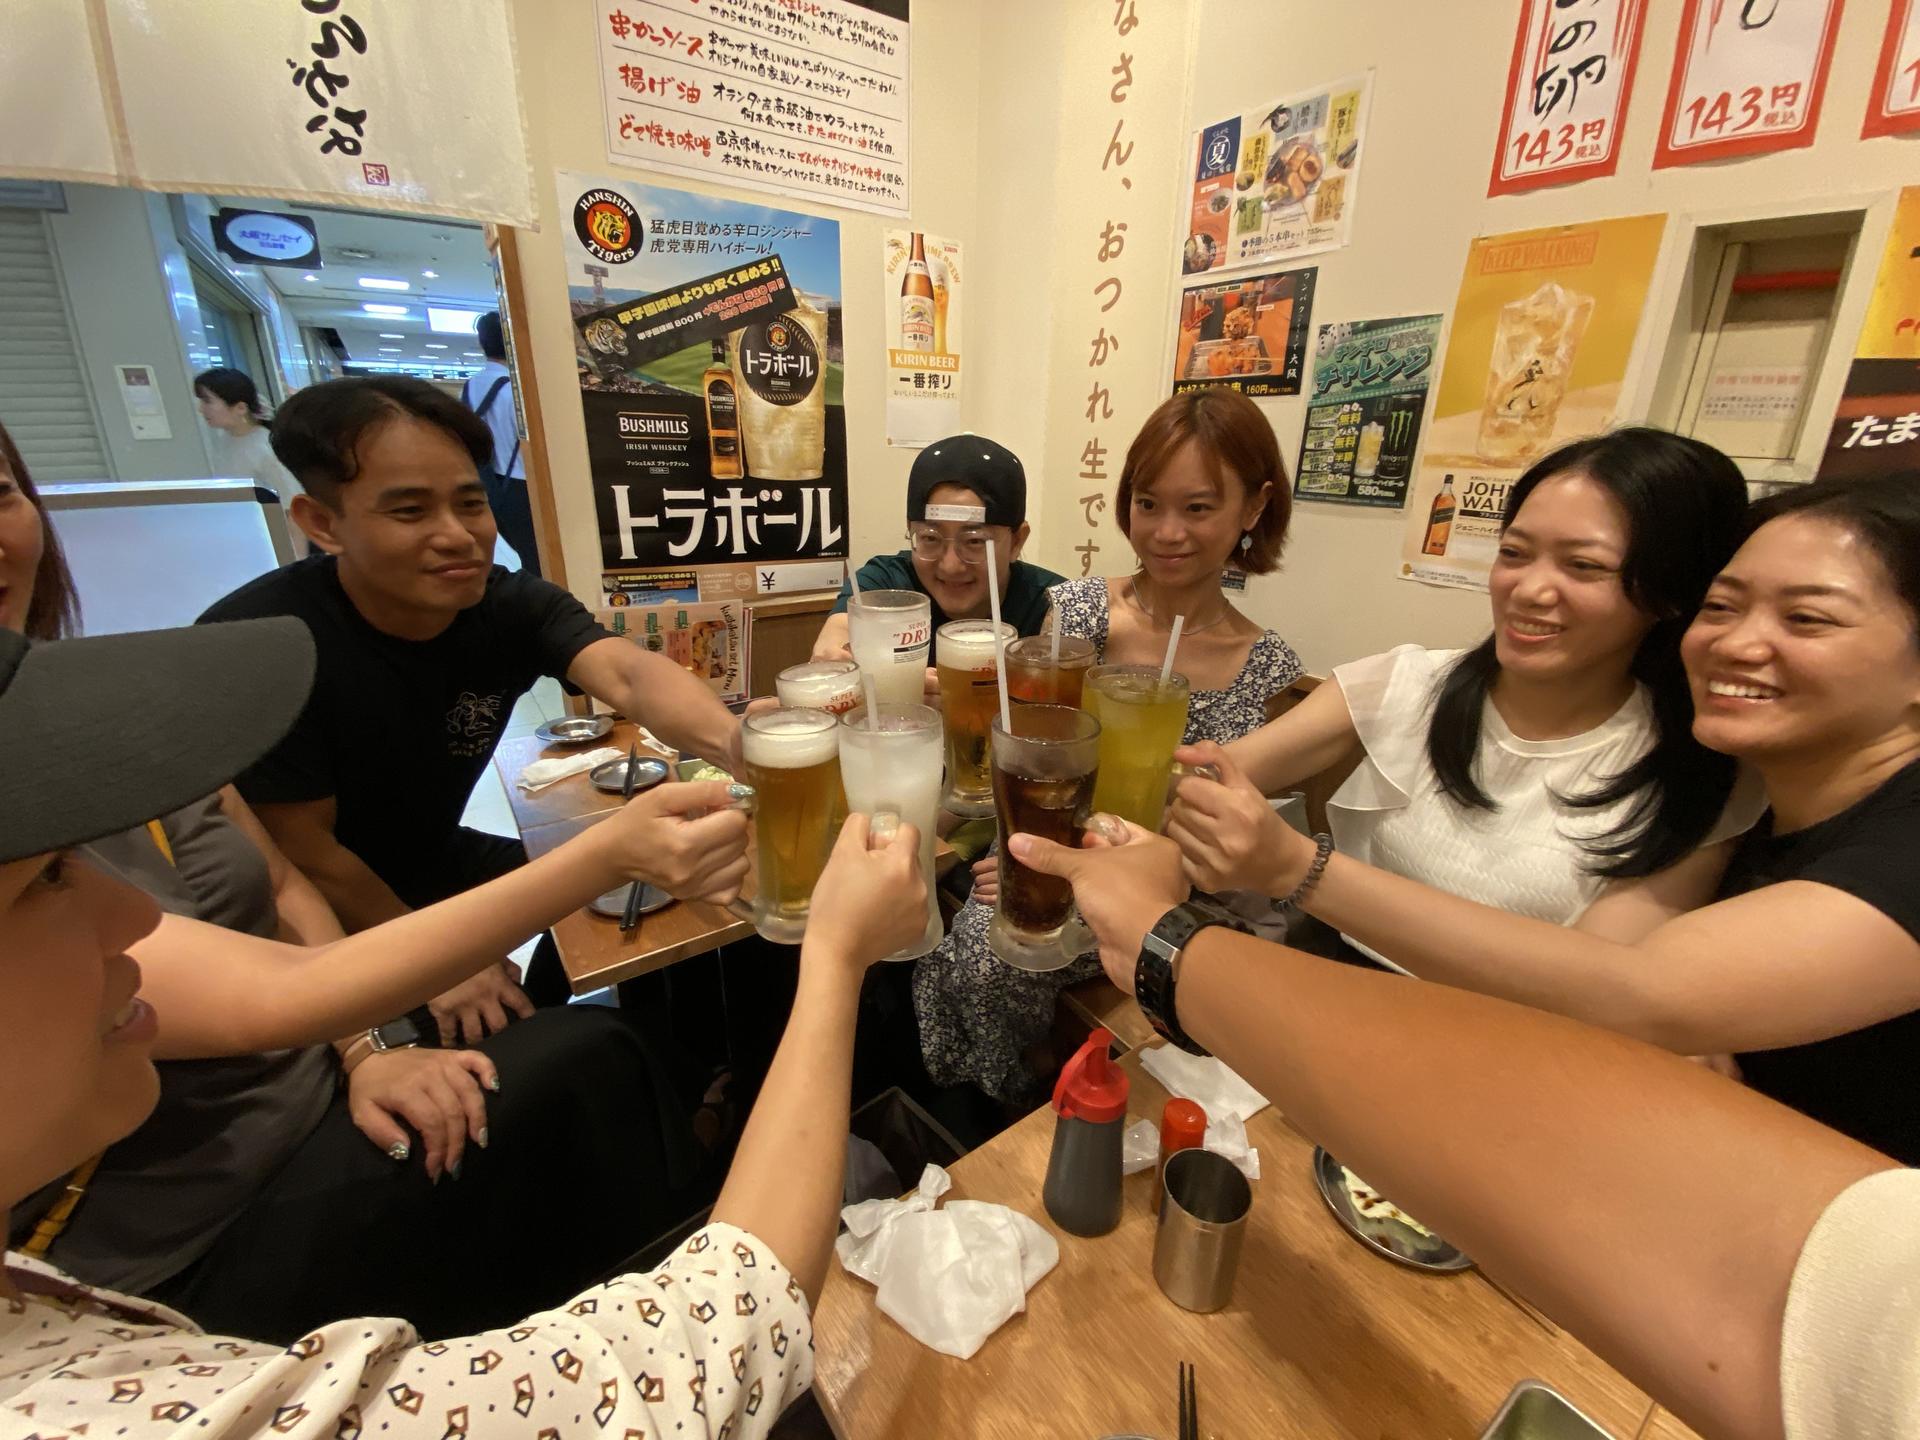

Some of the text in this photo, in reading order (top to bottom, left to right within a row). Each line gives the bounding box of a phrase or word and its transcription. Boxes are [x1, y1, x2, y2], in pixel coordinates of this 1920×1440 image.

[609, 9, 704, 59] 串かつソース
[618, 63, 701, 104] 揚げ油
[1533, 0, 1607, 124] の卵
[1686, 82, 1802, 140] 143円
[619, 113, 712, 158] どて焼き味噌
[1512, 118, 1606, 170] 143円
[579, 191, 635, 262] HANSHIN Tigers
[650, 219, 812, 239] 猛虎目覚める辛口ジンジャー
[650, 238, 773, 256] 虎党専用ハイボール!
[745, 349, 815, 378] トラボール
[895, 352, 956, 369] KIRIN BEER
[899, 372, 952, 390] 一番搾り
[1315, 344, 1433, 394] チャレンジ
[1246, 384, 1268, 395] 160円
[619, 417, 689, 434] BUSHMILLS
[610, 485, 842, 560] トラボール
